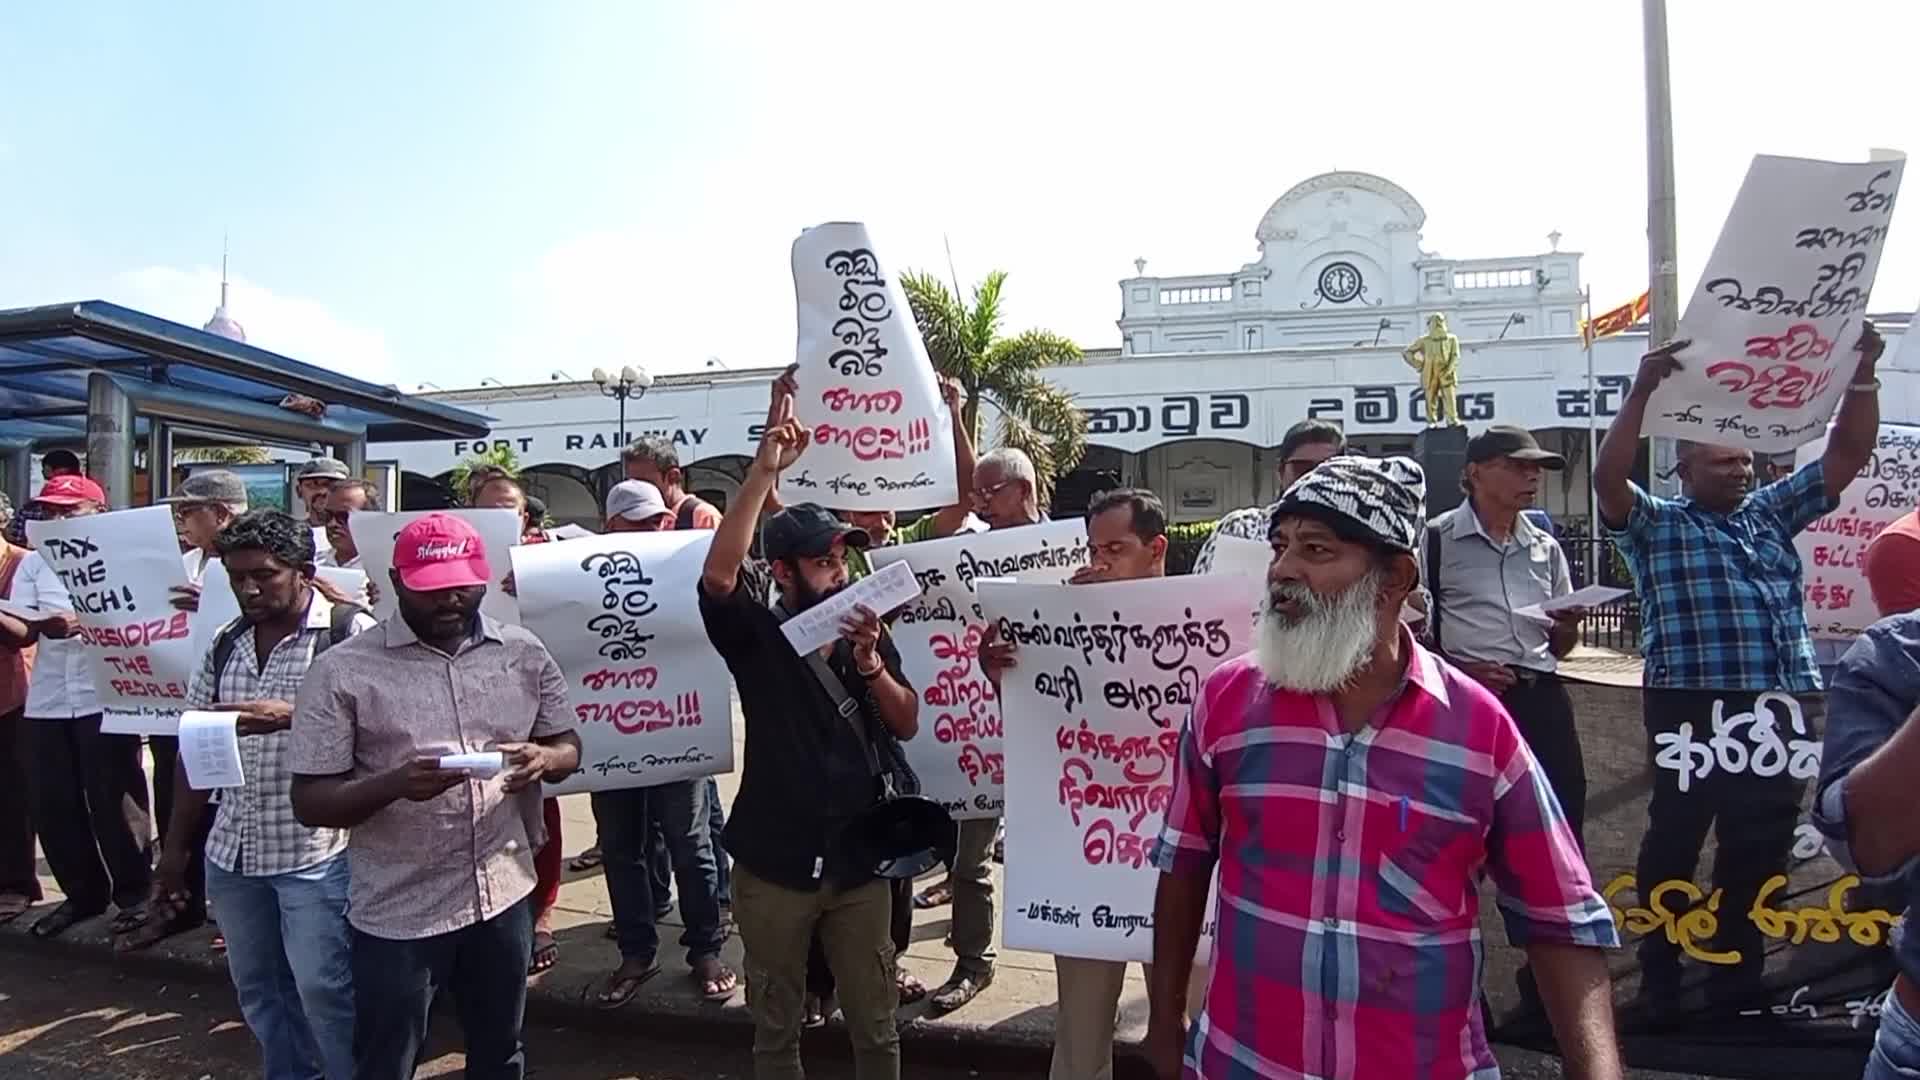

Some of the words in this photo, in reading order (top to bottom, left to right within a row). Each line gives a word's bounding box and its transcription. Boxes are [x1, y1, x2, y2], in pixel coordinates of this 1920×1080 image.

[454, 437, 533, 456] FORT
[565, 427, 710, 451] RAILAY
[747, 425, 768, 442] S
[44, 536, 99, 561] TAX
[57, 560, 106, 588] THE
[104, 655, 153, 676] THE
[1035, 665, 1083, 713] வரி
